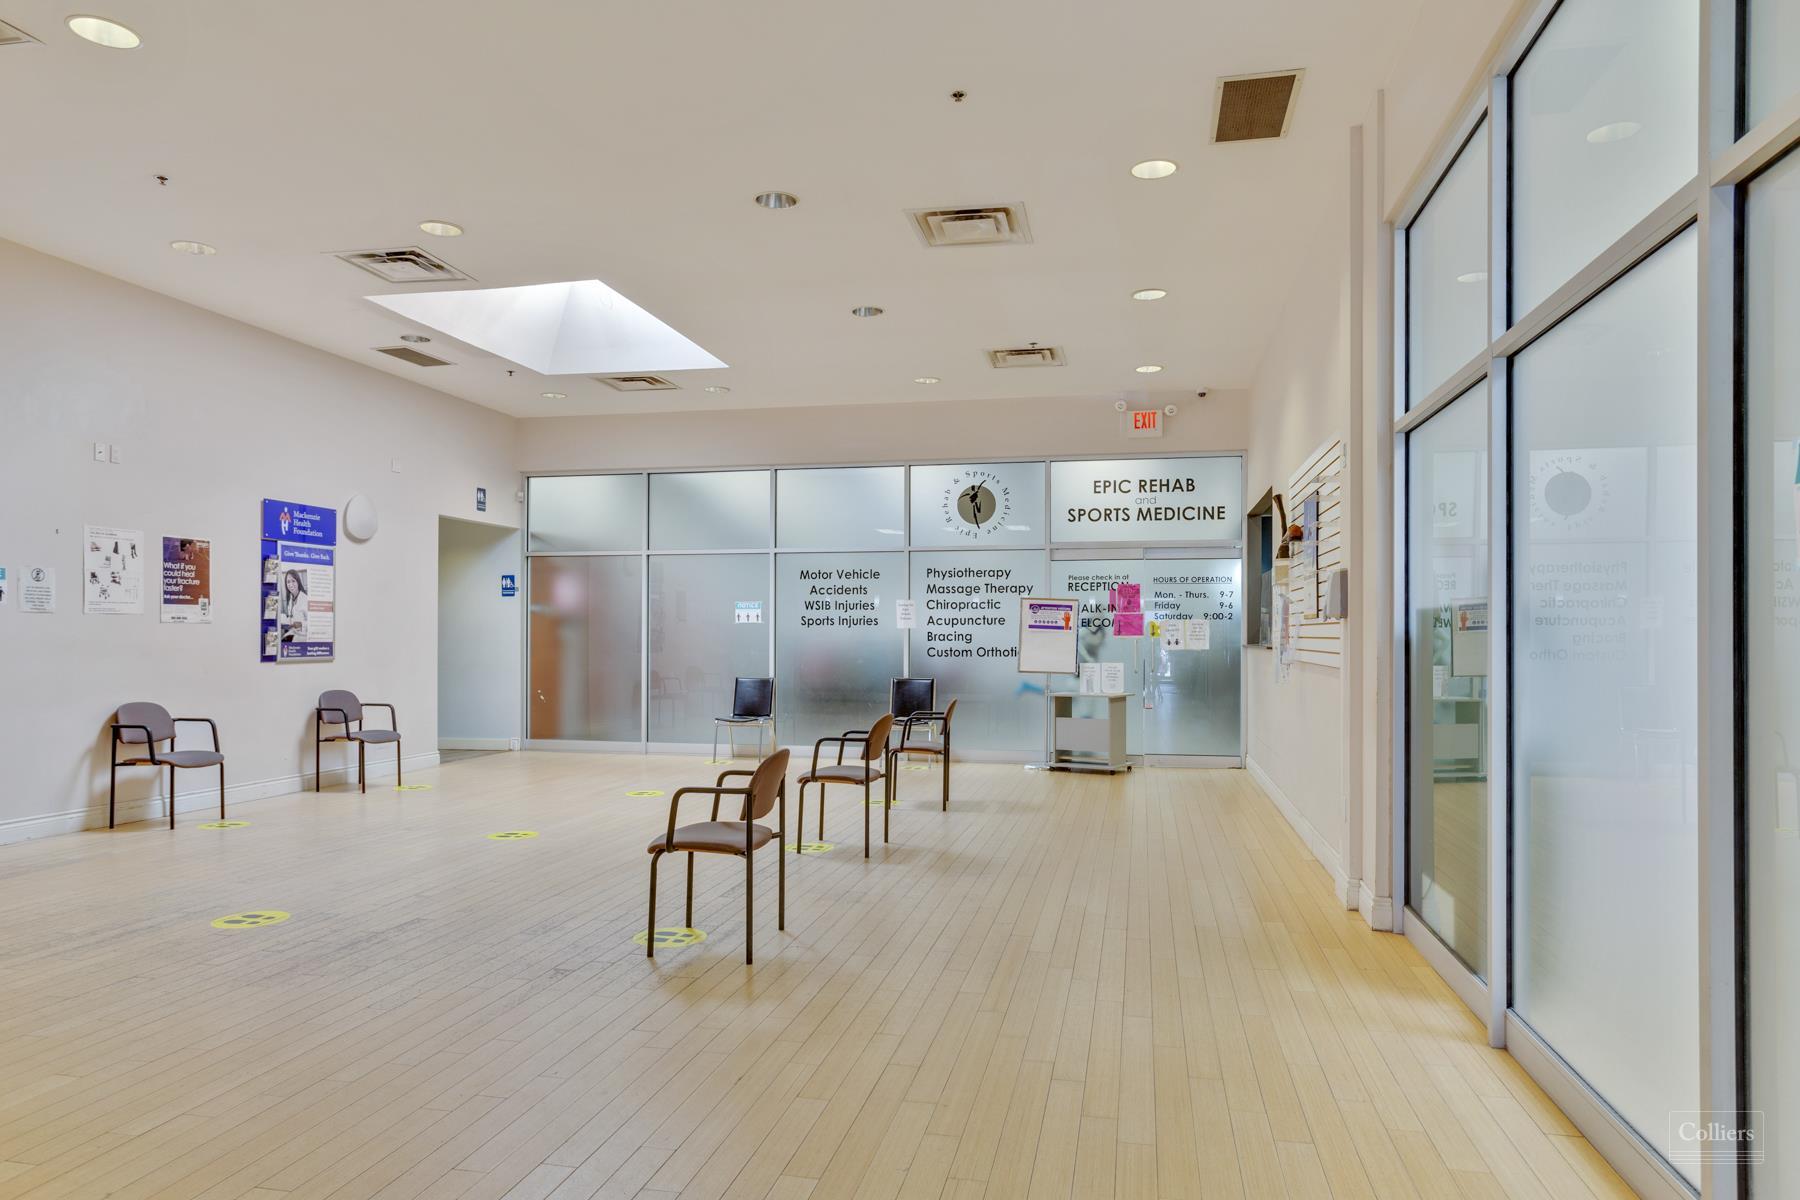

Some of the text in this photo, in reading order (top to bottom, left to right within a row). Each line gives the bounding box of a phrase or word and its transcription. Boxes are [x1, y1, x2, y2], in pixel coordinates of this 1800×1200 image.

[1133, 411, 1157, 430] EXIT
[1093, 478, 1196, 494] EPIC REHAB
[1134, 495, 1157, 505] and
[293, 510, 321, 520] Mackenzie
[1067, 506, 1226, 522] SPORTS MEDICINE
[293, 518, 311, 528] Health
[293, 527, 323, 537] Foundation
[164, 562, 197, 572] What if you
[164, 569, 196, 578] could heal
[800, 568, 880, 580] Motor Vehicle
[926, 568, 1011, 580] Physiotherapy
[163, 577, 200, 586] your fracture
[1068, 581, 1128, 592] RECEPTIO
[809, 584, 868, 595] Accidents
[926, 583, 1034, 596] Massage Therapy
[1154, 591, 1176, 599] Mon.
[1185, 591, 1210, 599] Thurs.
[804, 600, 875, 613] WSIB Injuries
[926, 599, 1001, 612] Chiropractic
[1081, 603, 1117, 613] ALK-IN
[1154, 601, 1234, 611] Friday 9-6
[801, 615, 879, 628] Sports Injuries
[926, 615, 1006, 628] Acupuncture
[1154, 612, 1233, 620] Saturday 9:00-2
[1081, 617, 1115, 628] ELCO
[927, 631, 973, 644] Bracing
[926, 646, 1019, 658] Custom Orthoti
